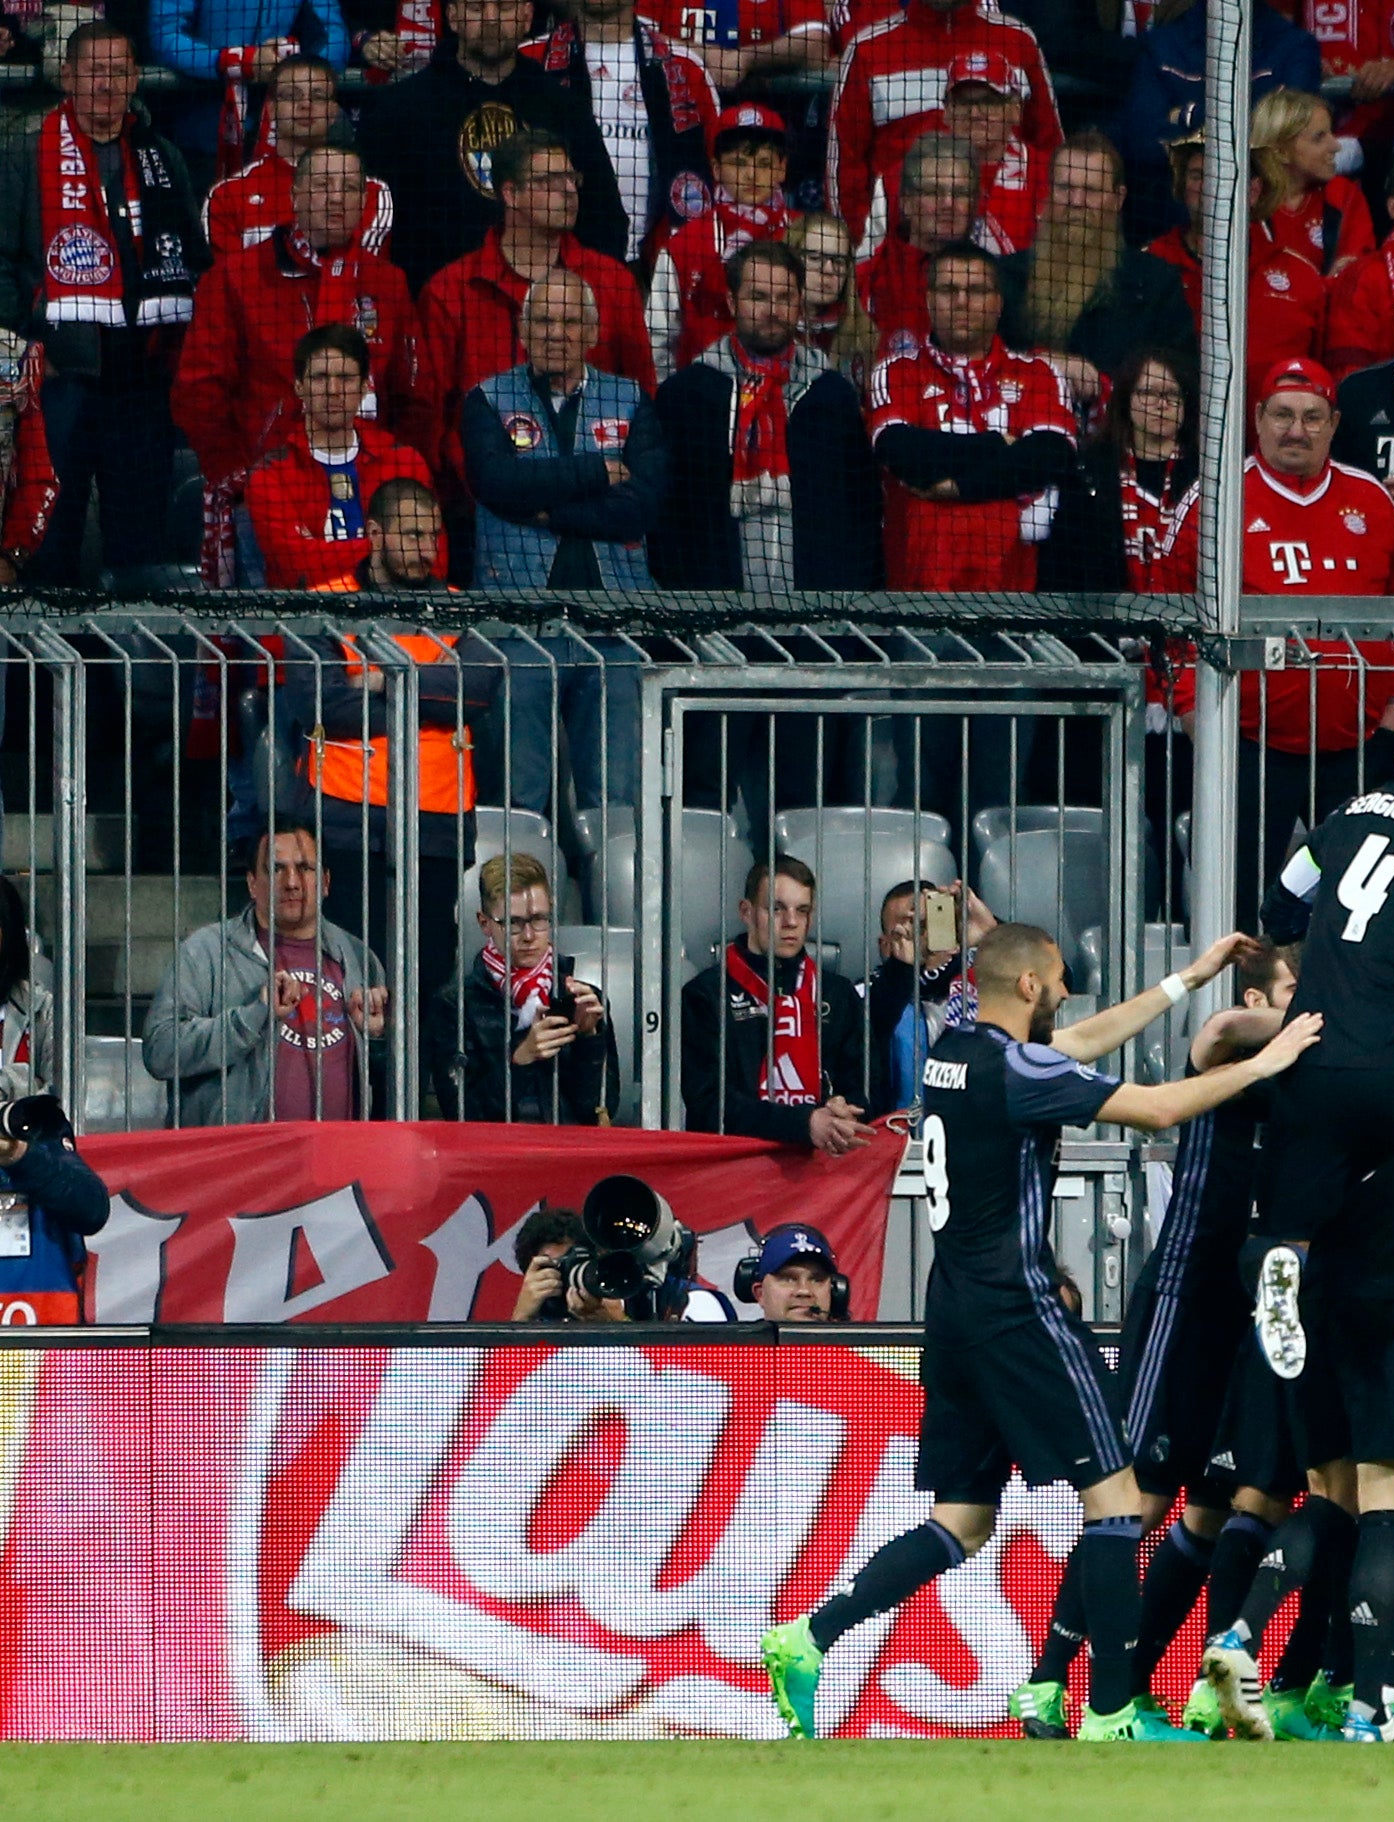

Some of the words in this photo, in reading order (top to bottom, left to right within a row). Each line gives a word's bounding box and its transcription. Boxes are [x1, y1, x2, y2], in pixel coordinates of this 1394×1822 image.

[1315, 3, 1347, 42] FC
[62, 181, 87, 211] FC
[645, 1012, 659, 1034] 9
[923, 1114, 950, 1232] 9
